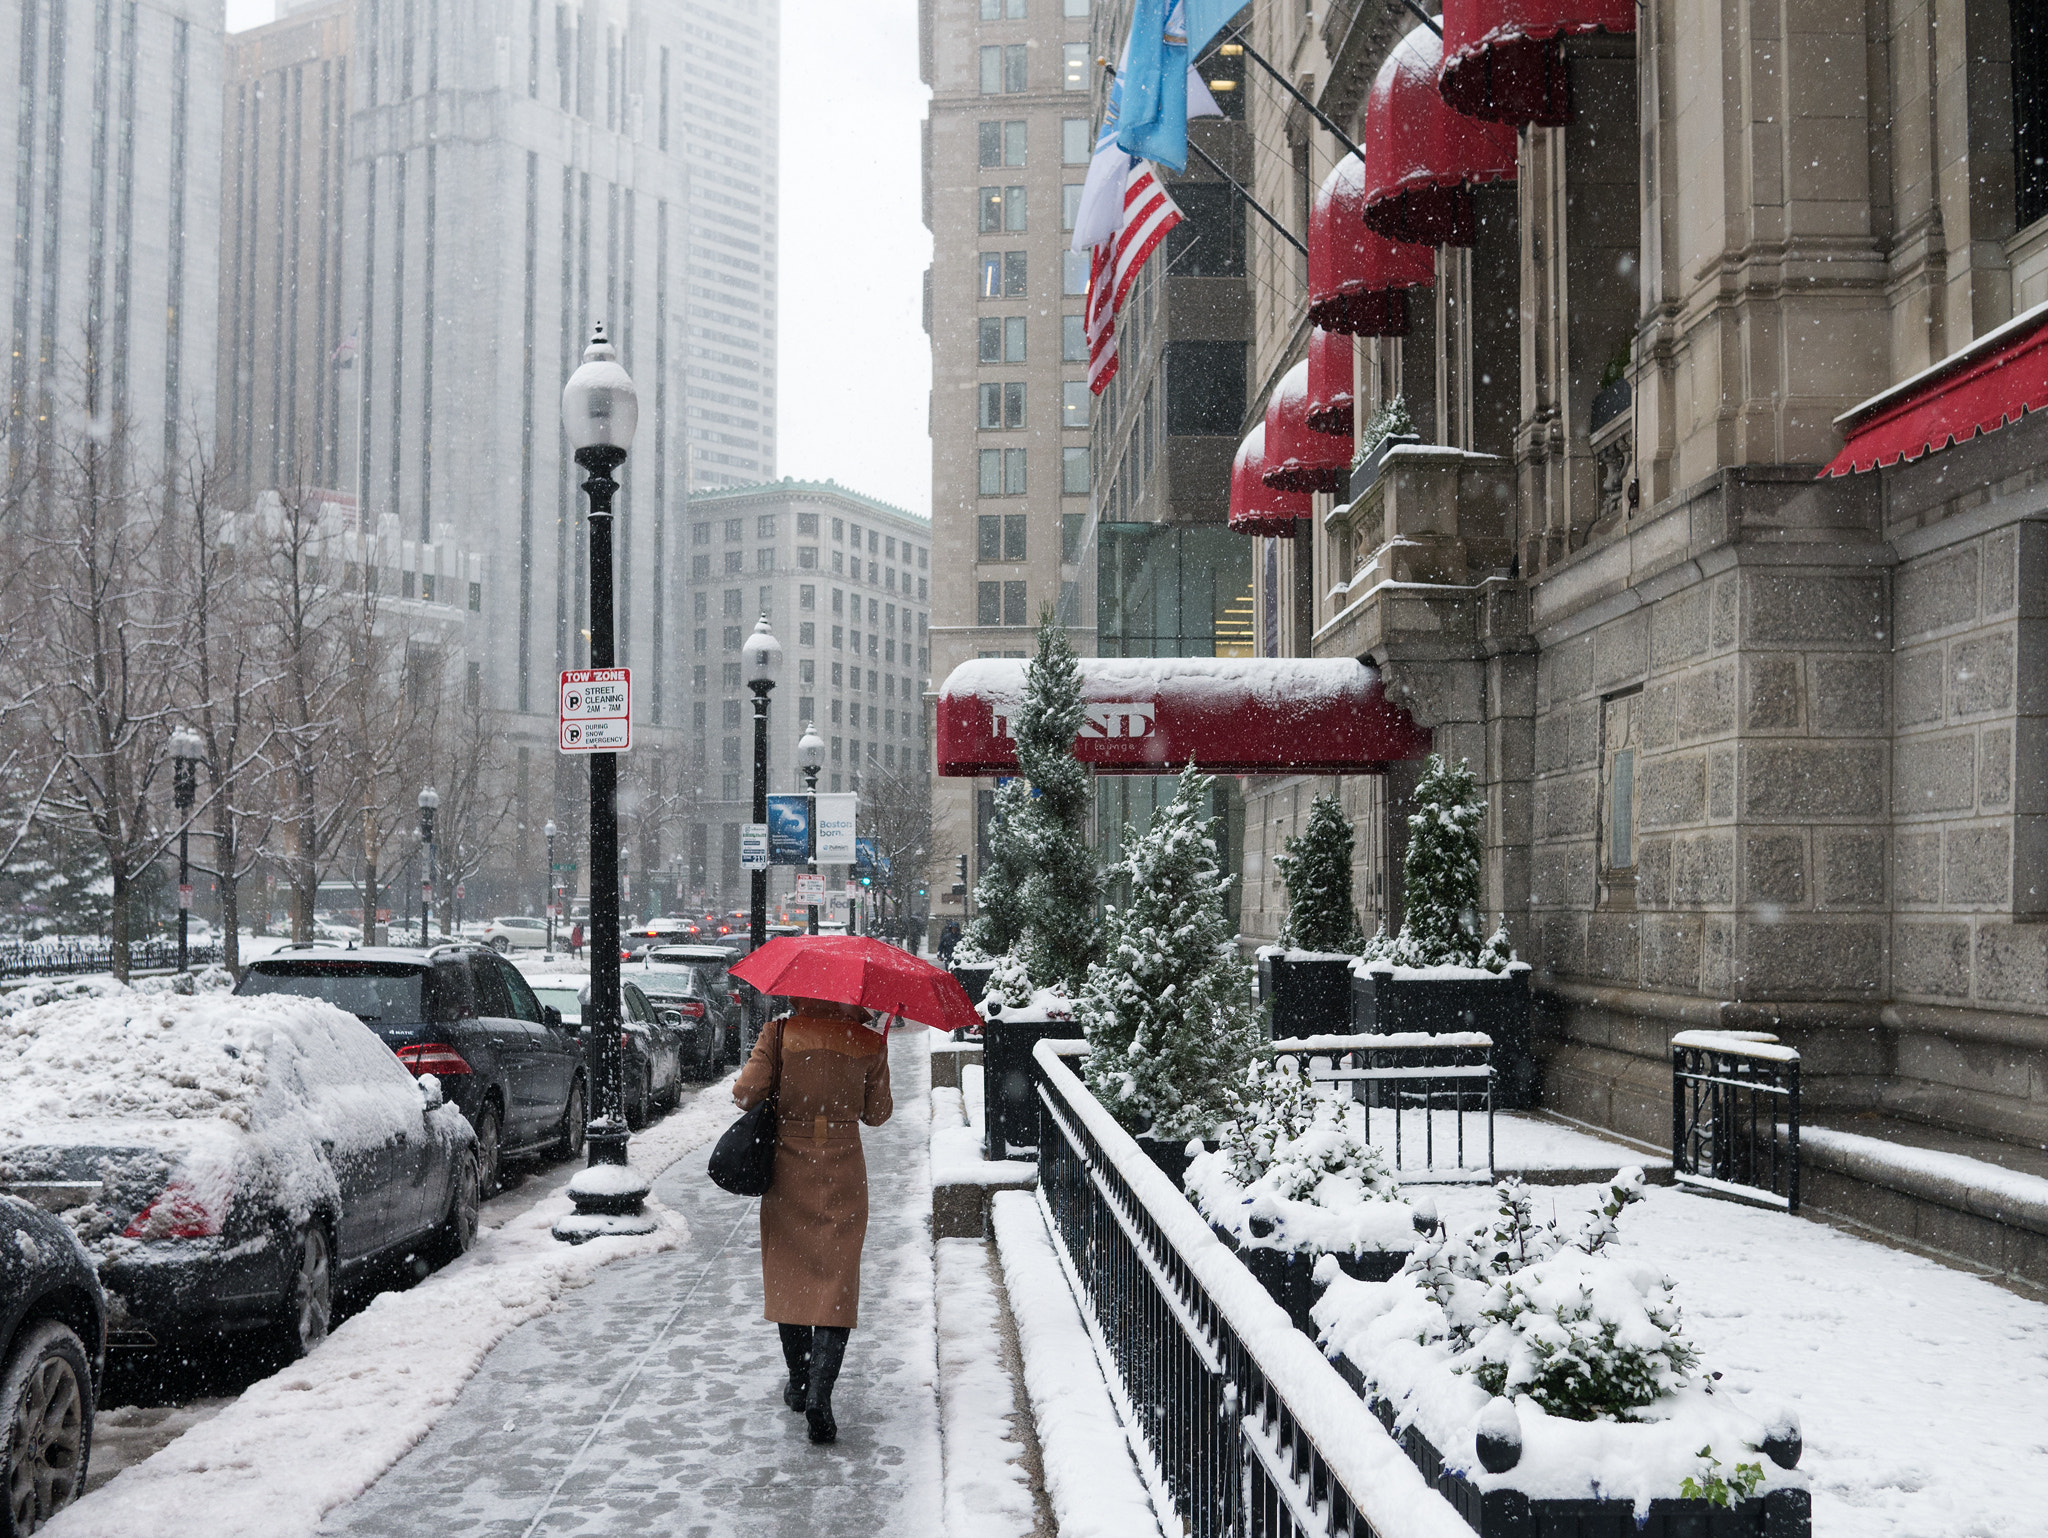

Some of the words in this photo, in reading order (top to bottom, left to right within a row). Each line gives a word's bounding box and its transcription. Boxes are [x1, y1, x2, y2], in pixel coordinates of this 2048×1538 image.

[566, 673, 590, 682] TOW
[594, 671, 626, 681] ZONE
[585, 686, 615, 695] STREET
[585, 694, 624, 704] CLEANING
[587, 705, 600, 713] 2AM
[608, 704, 621, 712] 7AM
[585, 736, 623, 744] EMERGENCY
[1094, 740, 1135, 751] lounge
[819, 820, 853, 829] Boston
[819, 829, 844, 837] born.
